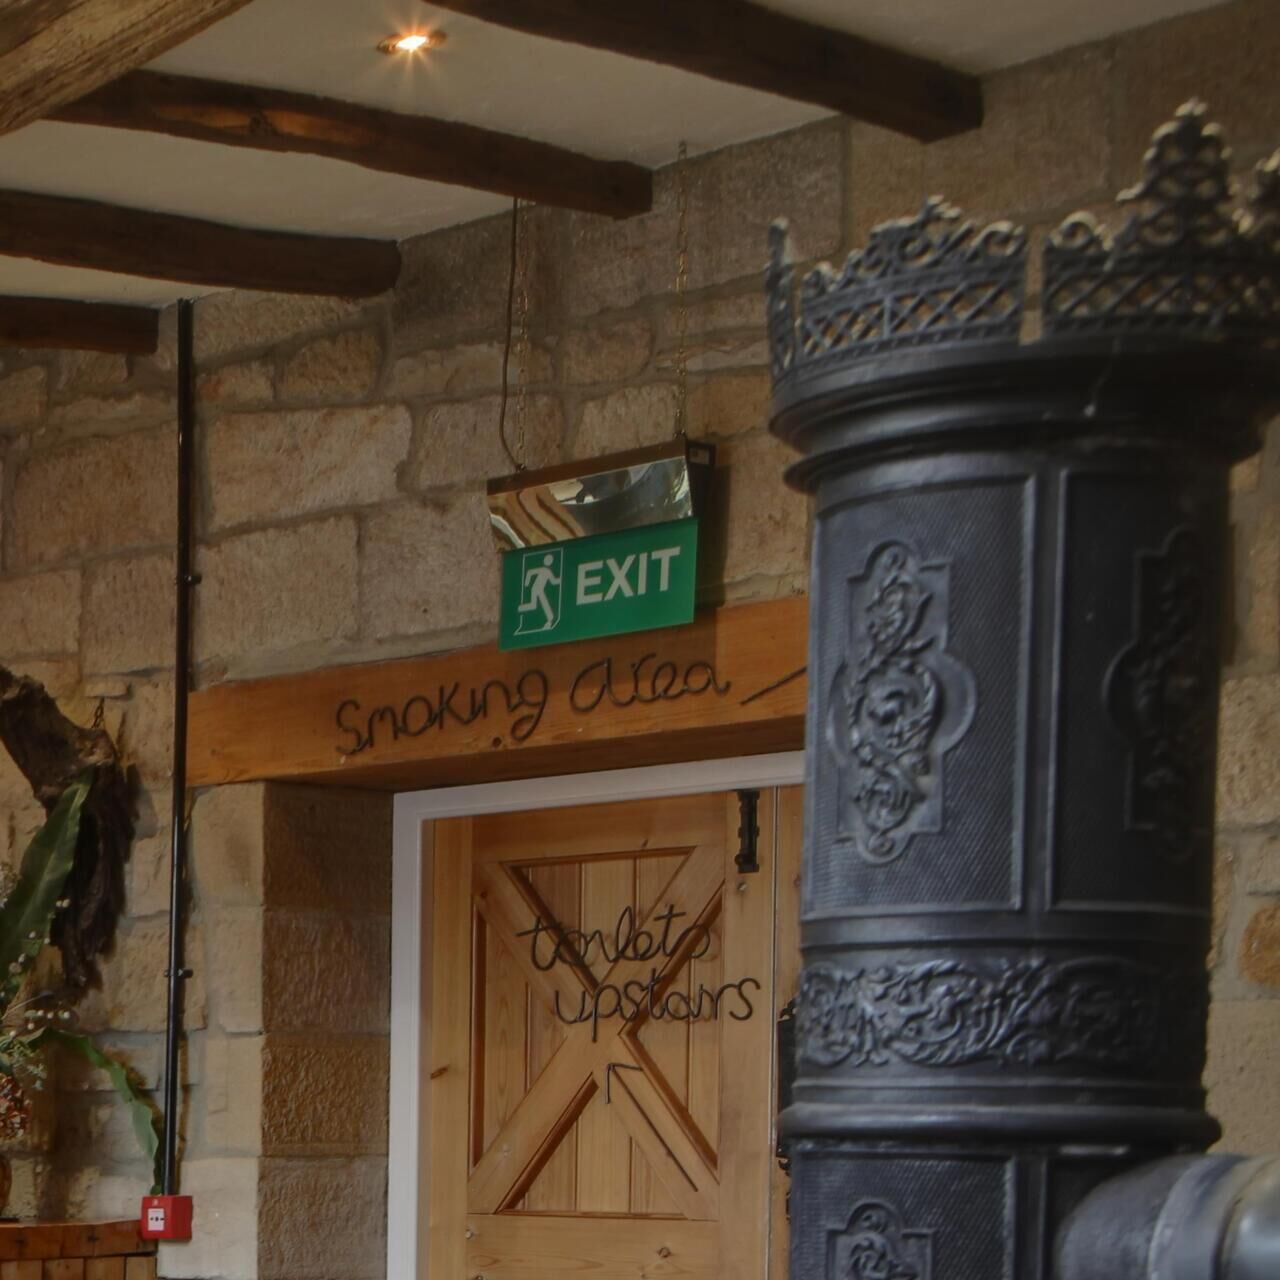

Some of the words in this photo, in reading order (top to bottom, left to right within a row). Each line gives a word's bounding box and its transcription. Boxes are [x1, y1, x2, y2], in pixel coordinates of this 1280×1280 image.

[576, 547, 681, 606] EXIT
[569, 653, 732, 713] area
[515, 903, 711, 971] toilets
[554, 967, 761, 1043] upstairs
